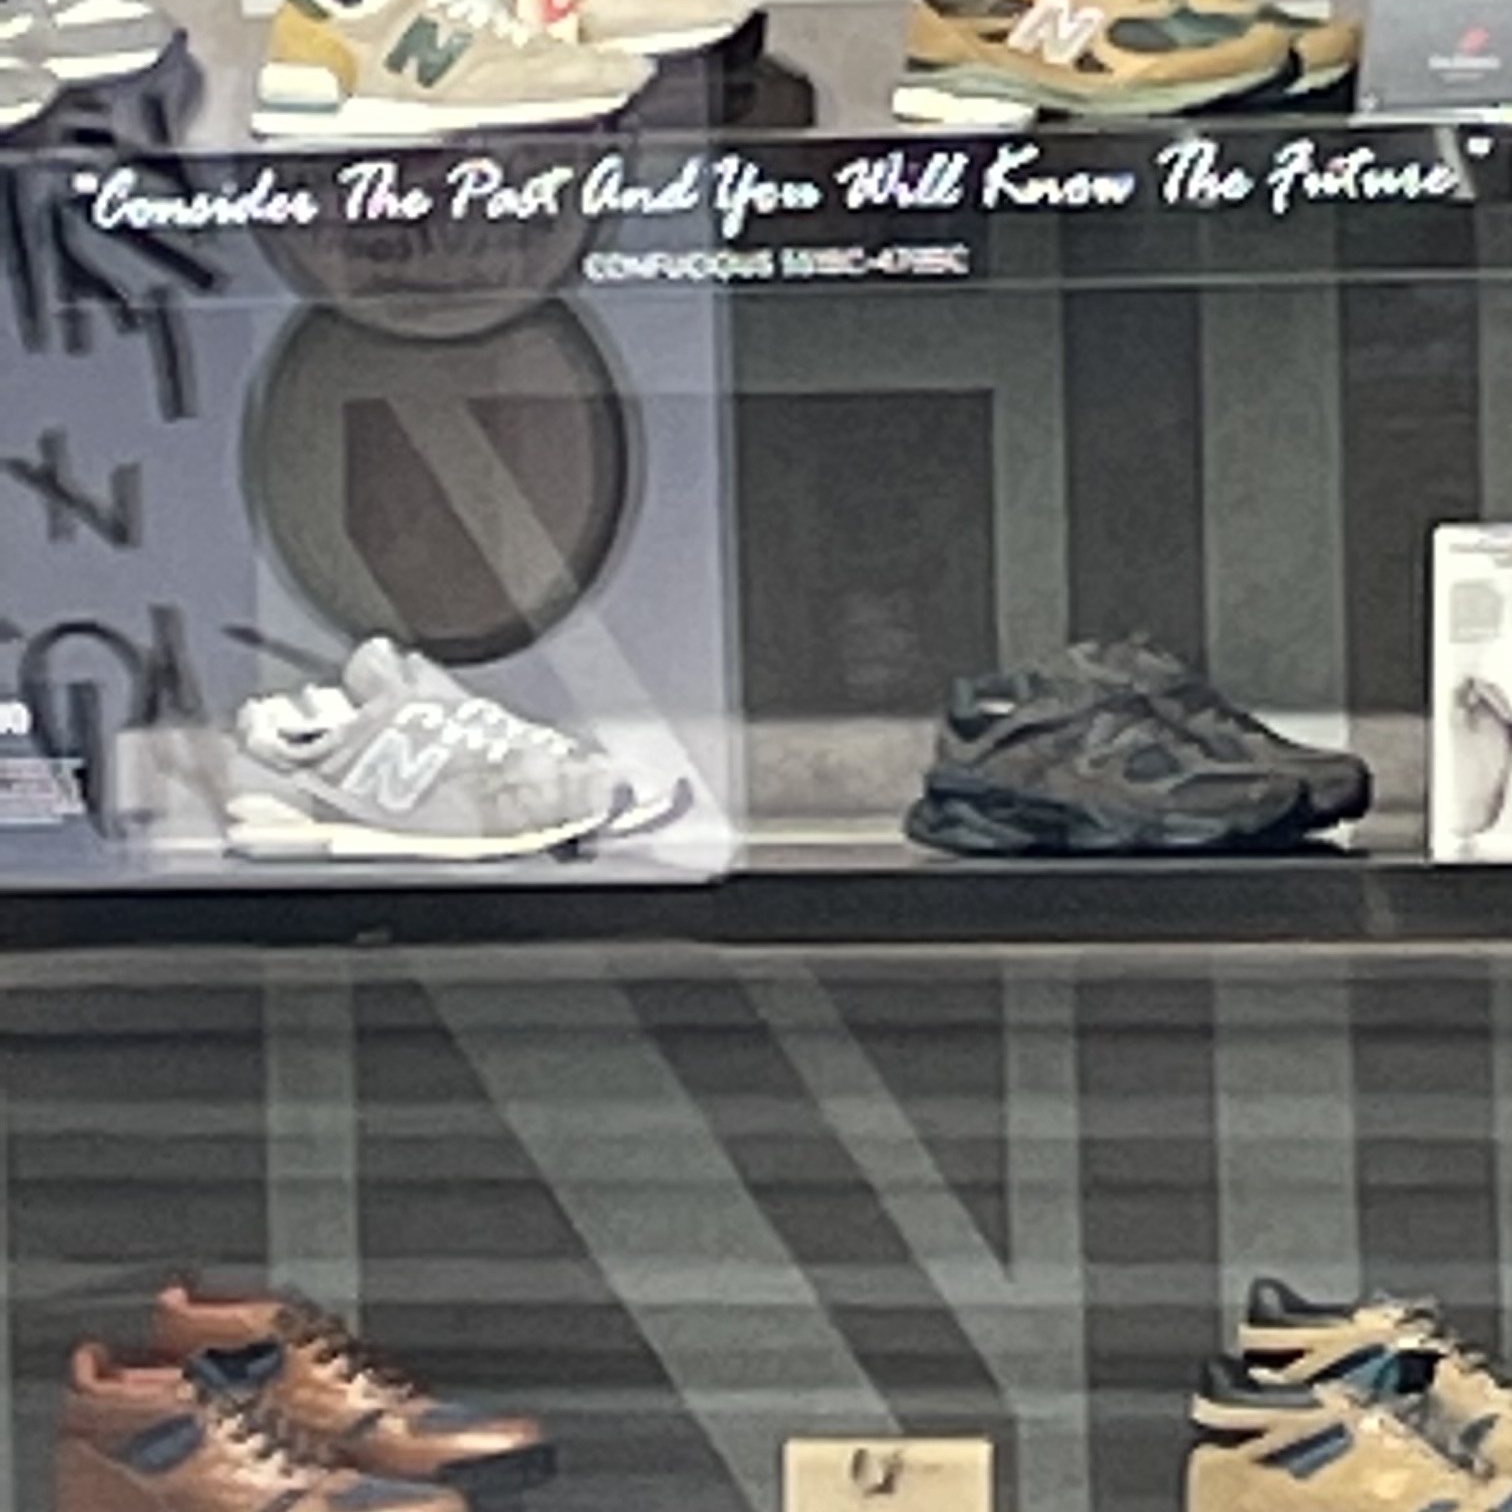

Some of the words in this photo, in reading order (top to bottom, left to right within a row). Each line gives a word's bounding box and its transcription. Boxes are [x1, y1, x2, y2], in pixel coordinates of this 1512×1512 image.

[384, 14, 474, 89] N
[337, 160, 432, 220] The
[447, 156, 575, 219] Past
[581, 152, 704, 216] And
[712, 152, 821, 239] You
[834, 150, 970, 210] Will
[981, 143, 1136, 208] Know
[1156, 139, 1253, 204] The
